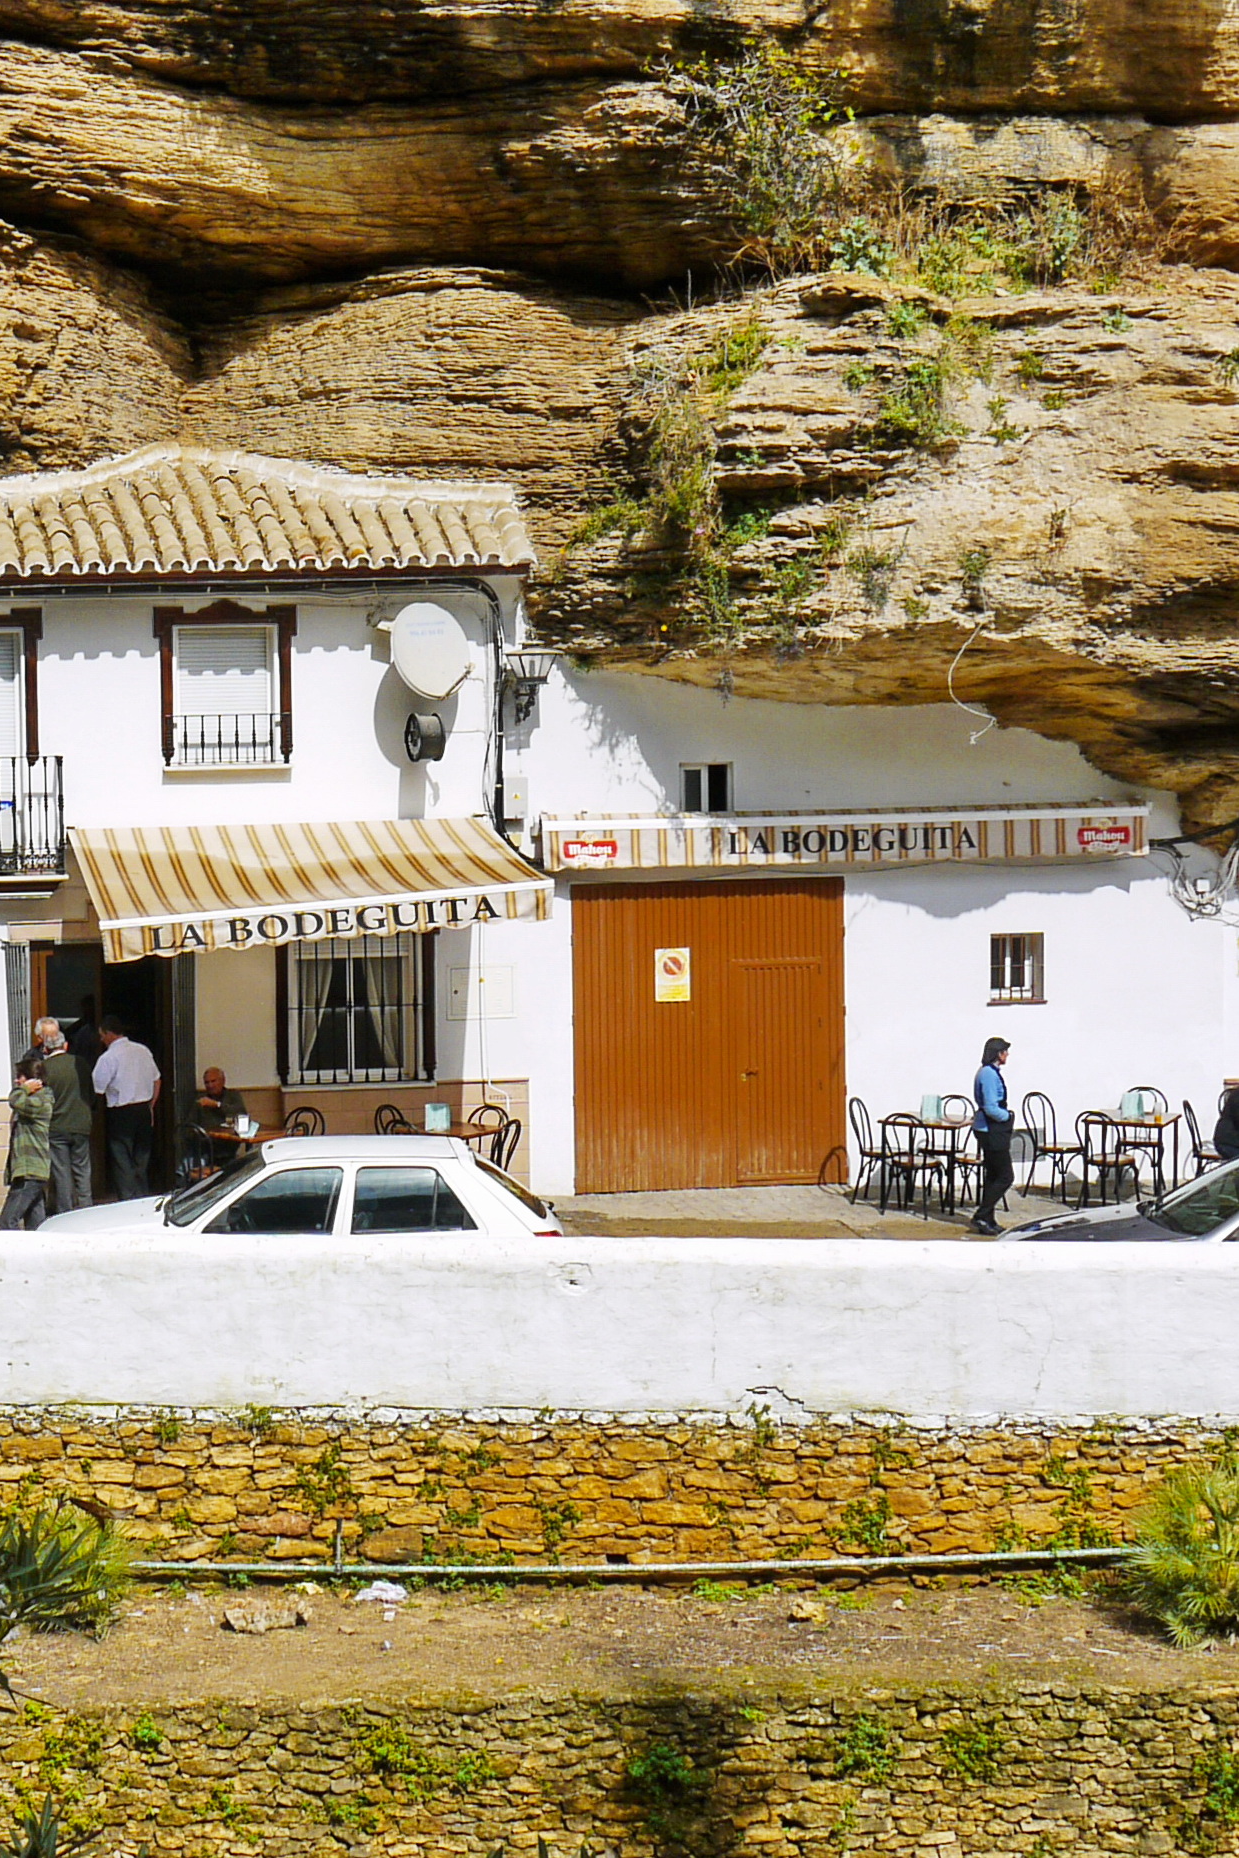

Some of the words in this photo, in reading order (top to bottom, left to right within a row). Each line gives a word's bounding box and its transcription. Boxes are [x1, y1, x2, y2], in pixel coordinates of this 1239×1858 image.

[729, 831, 771, 855] LA
[782, 826, 977, 853] BODEGUITA
[1083, 830, 1125, 842] Mahou
[567, 843, 613, 855] Mahou
[151, 922, 207, 951] LA
[228, 895, 502, 944] BODEGUITA
